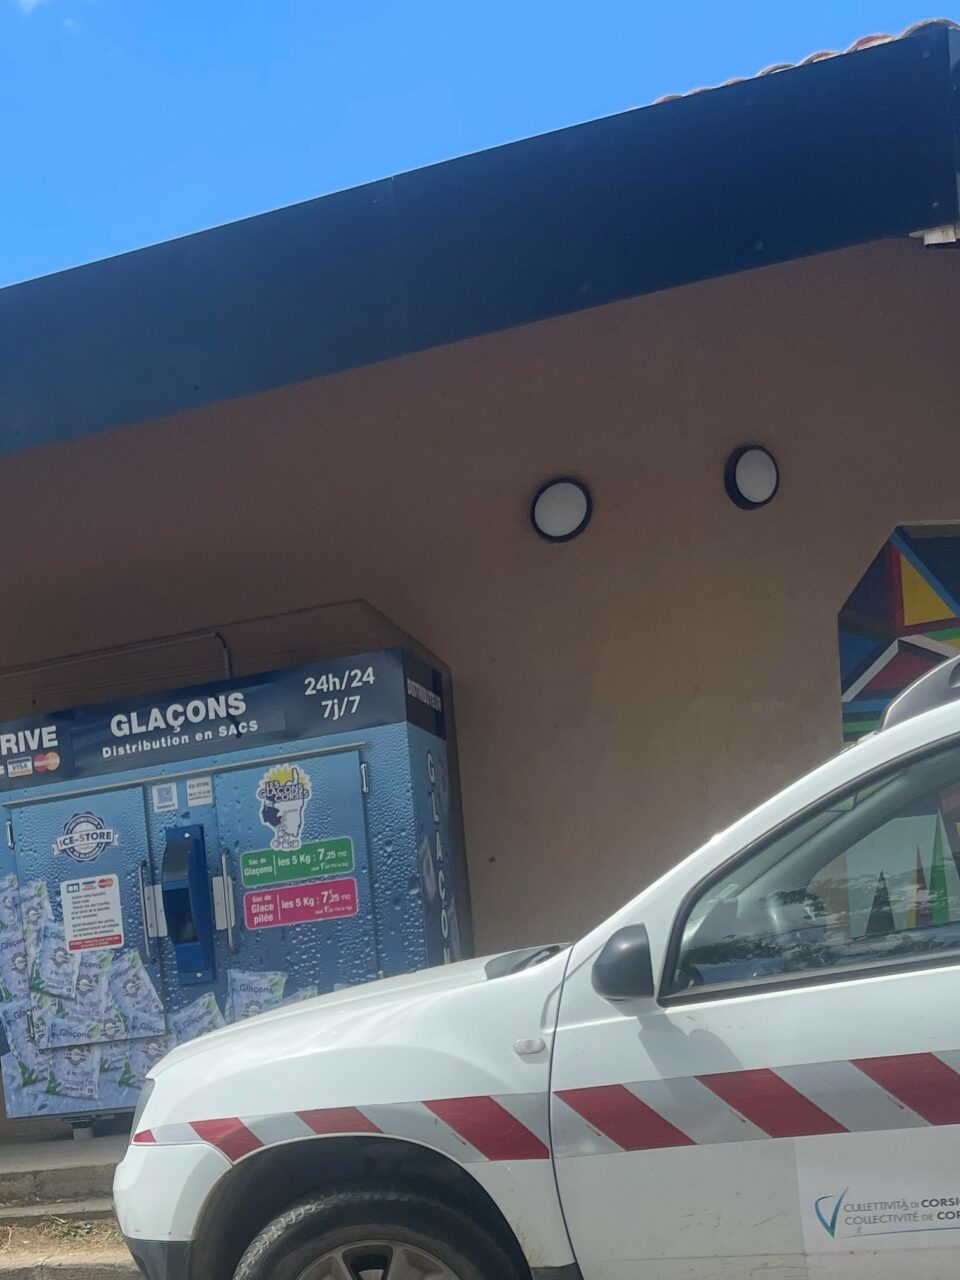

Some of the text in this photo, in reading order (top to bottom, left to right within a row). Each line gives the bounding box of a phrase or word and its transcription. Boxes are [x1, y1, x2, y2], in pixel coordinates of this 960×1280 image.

[304, 667, 375, 696] 24h/24
[110, 692, 247, 738] GLAÇONS
[321, 696, 361, 721] 7j/7
[102, 720, 258, 758] Distribution en SACS
[259, 784, 304, 798] GLAÇONS
[266, 781, 280, 790] LES
[275, 789, 309, 802] CORSES
[60, 831, 112, 848] ICE-STORE
[278, 857, 291, 867] les
[292, 855, 298, 865] 5
[299, 853, 311, 866] Kg
[244, 866, 273, 878] Glaçons
[251, 903, 274, 914] Glace
[281, 898, 294, 909] les
[295, 897, 302, 907] 5
[302, 896, 315, 909] Kg
[253, 913, 274, 926] pilée
[910, 1201, 919, 1209] DI
[921, 1197, 960, 1208] CORSI
[844, 1212, 919, 1226] COLLECTIVITÉ
